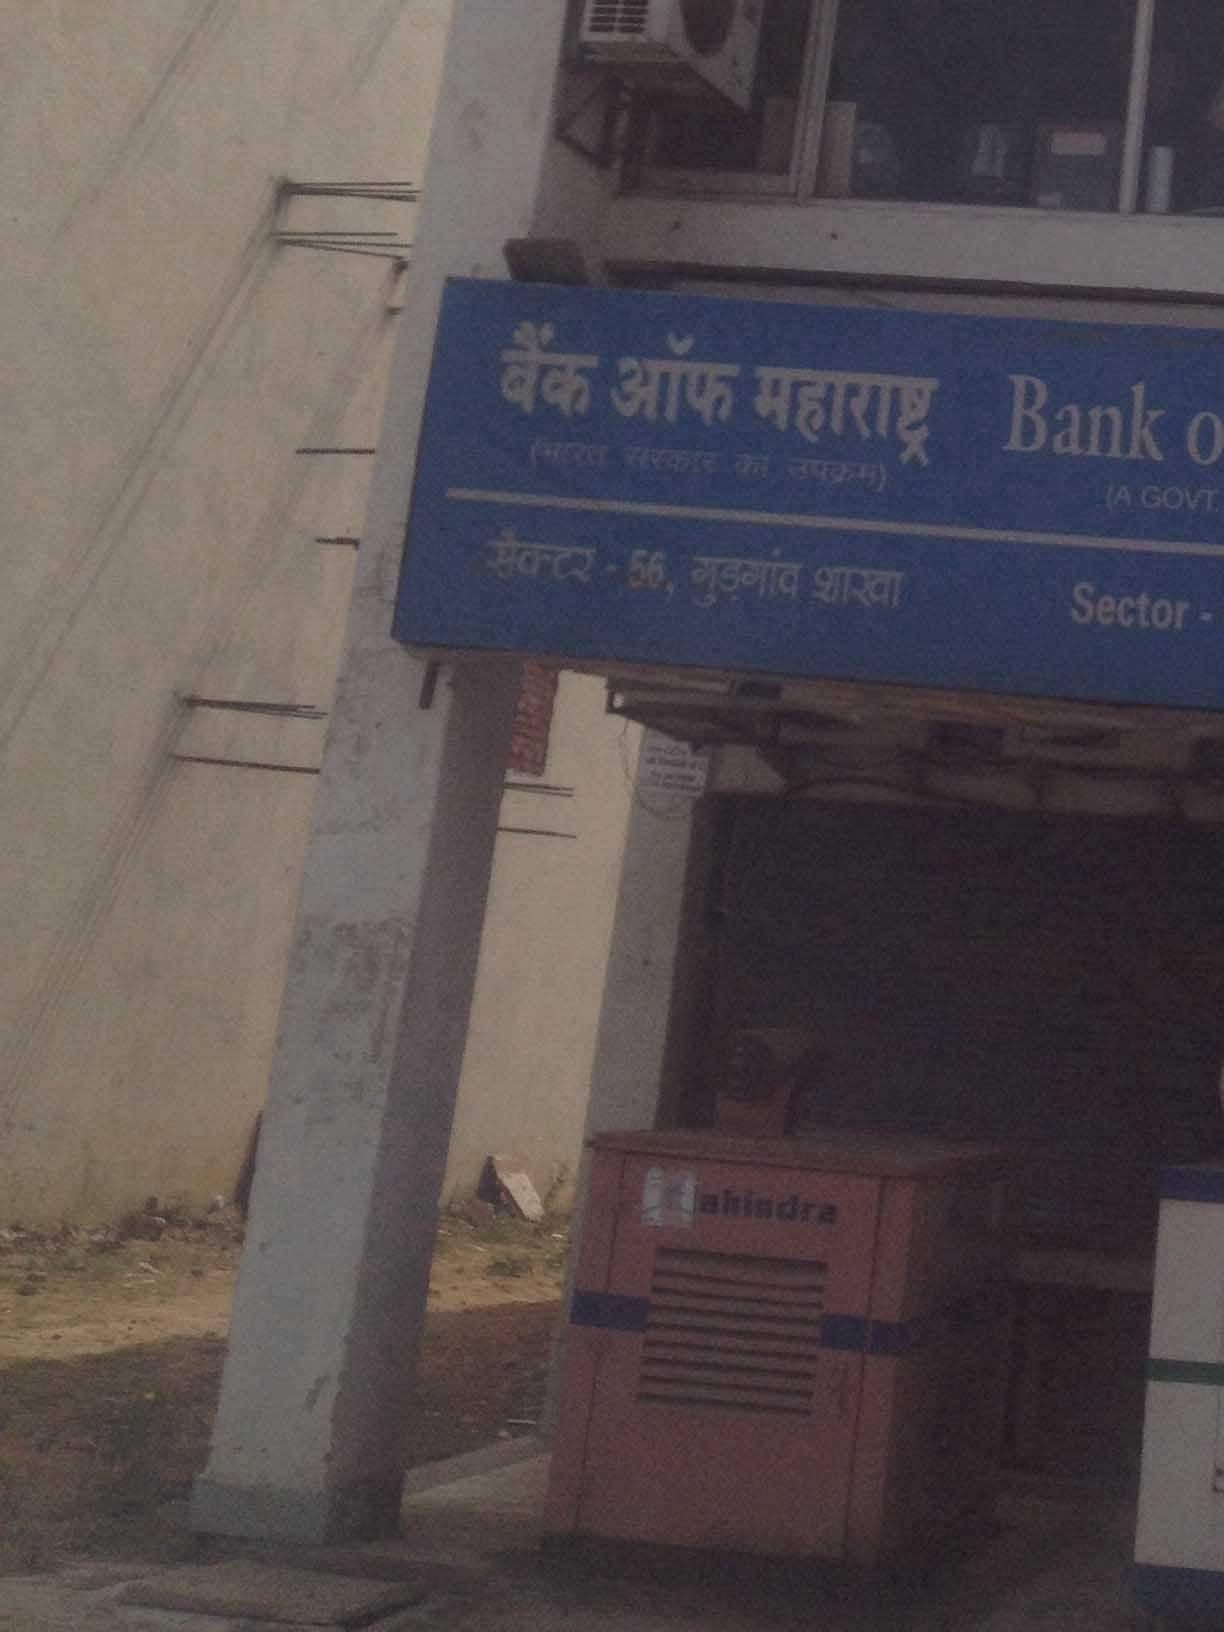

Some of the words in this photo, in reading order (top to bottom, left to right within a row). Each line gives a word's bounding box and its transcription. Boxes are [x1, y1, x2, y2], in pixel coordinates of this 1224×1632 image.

[500, 320, 600, 416] बैंक
[752, 365, 940, 467] महाराष्ट्र
[1003, 373, 1165, 464] Bank
[1141, 485, 1220, 514] GOVT.
[1071, 580, 1188, 631] Sector
